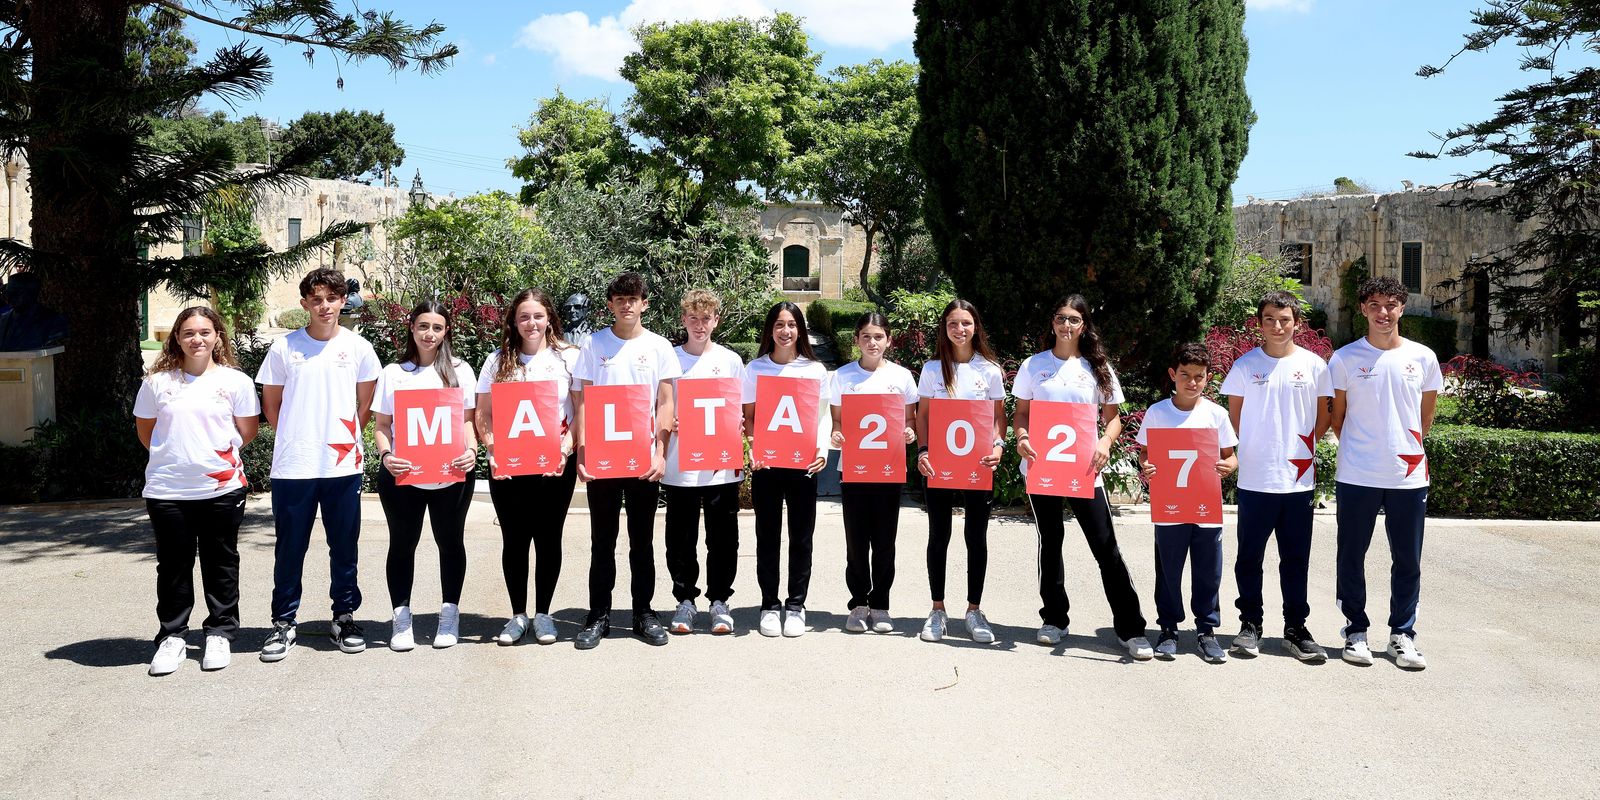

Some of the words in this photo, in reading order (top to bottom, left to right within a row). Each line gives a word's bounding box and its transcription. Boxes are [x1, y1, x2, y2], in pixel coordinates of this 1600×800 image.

[407, 406, 452, 446] M
[508, 400, 546, 439] A
[604, 404, 633, 441] L
[694, 398, 726, 436] T
[767, 395, 804, 434] A
[859, 414, 888, 450] 2
[946, 420, 976, 456] 0
[1045, 424, 1077, 462] 2
[1168, 450, 1198, 488] 7
